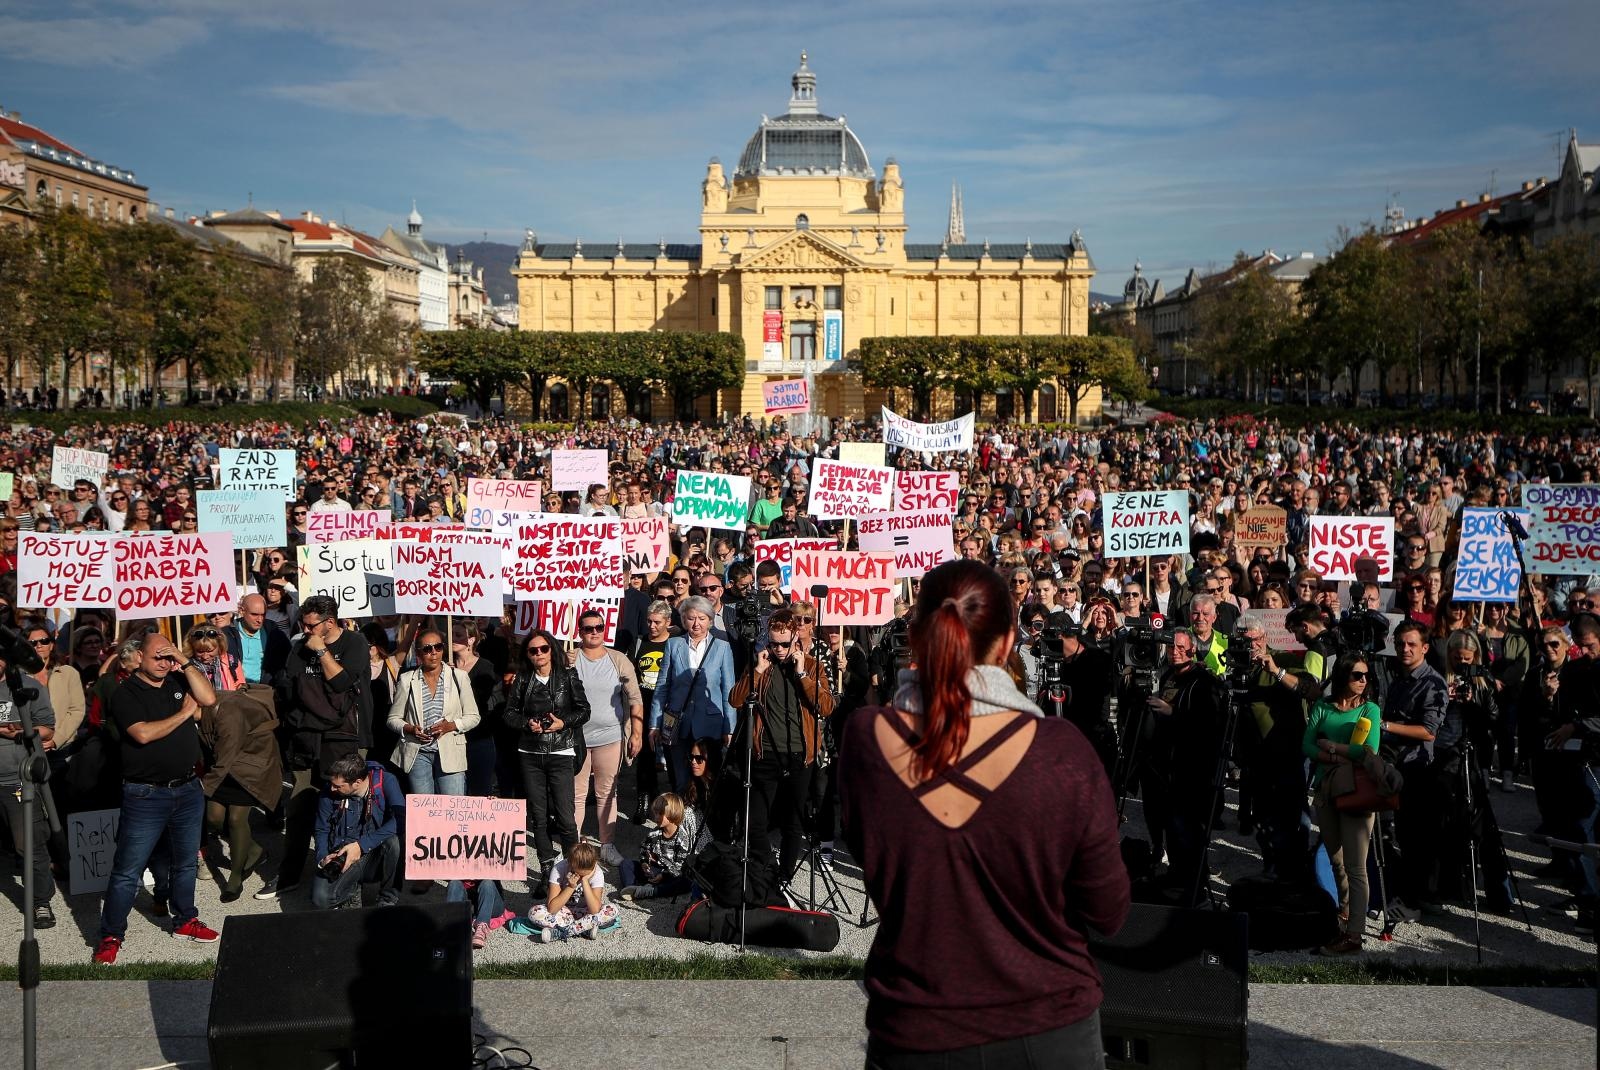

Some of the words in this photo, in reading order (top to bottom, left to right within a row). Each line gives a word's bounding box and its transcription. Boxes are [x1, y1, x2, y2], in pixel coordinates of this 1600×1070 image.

[235, 451, 277, 465] END
[228, 467, 279, 481] RAPE
[819, 463, 890, 484] FEMINIZAM
[473, 481, 537, 500] GLASNE
[677, 473, 733, 500] NEMA
[819, 477, 837, 490] JE
[837, 478, 854, 492] ZA
[857, 481, 883, 495] SVE
[815, 491, 853, 504] PRAVDA
[857, 495, 870, 504] ZA
[1112, 493, 1168, 510] ŽENE
[209, 504, 240, 514] PROTIV
[858, 519, 883, 533] BEZ
[887, 513, 952, 532] PRISTANKA
[1111, 511, 1182, 528] KONTRA
[1238, 516, 1286, 528] SILOVANJE
[518, 521, 620, 541] INSTITUCIJE
[1110, 531, 1183, 551] SISTEMA
[1311, 522, 1387, 549] NISTE
[22, 536, 109, 562] POŠTUJ
[114, 536, 208, 562] SNAŽNA
[318, 545, 357, 573] Što
[397, 545, 453, 564] NISAM
[517, 543, 554, 562] KOJE
[1458, 540, 1488, 566] SE
[48, 561, 104, 584] MOJE
[116, 558, 211, 582] HRABRA
[514, 551, 620, 577] ZLOSTAVLJAČE
[795, 553, 819, 577] NI
[826, 552, 895, 580] MUČAT
[22, 581, 112, 606] TIJELO
[118, 581, 230, 611] ODVAŽNA
[395, 579, 484, 602] BORKINJA
[826, 587, 891, 617] TRPIT
[412, 797, 443, 808] SVAKI
[449, 798, 484, 809] SPOLNI
[490, 801, 521, 812] ODNOS
[428, 809, 442, 817] BEZ
[445, 809, 497, 821] PRISTANKA
[457, 824, 469, 833] JE
[412, 829, 525, 866] SILOVANJE
[78, 850, 108, 880] NE
